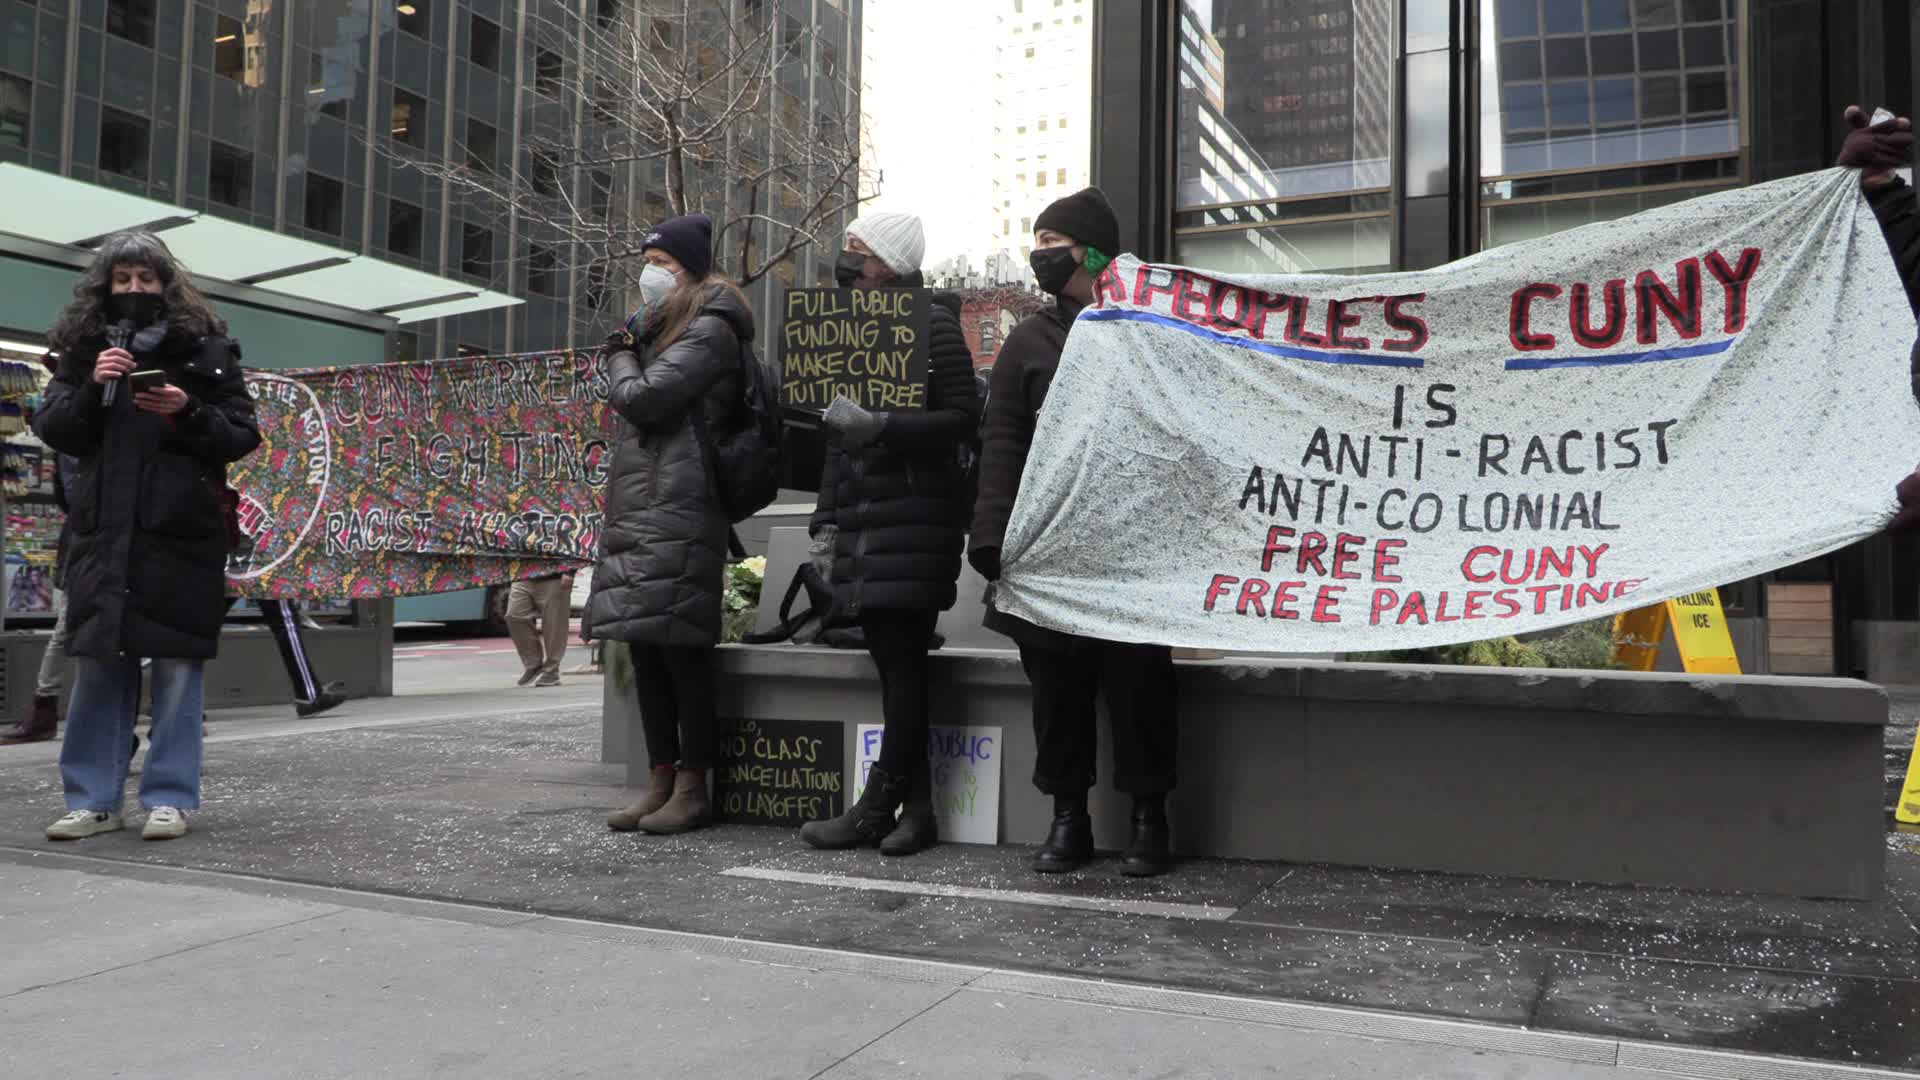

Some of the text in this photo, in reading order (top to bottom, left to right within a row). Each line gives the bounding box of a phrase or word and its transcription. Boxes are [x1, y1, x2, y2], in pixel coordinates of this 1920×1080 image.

[788, 289, 912, 318] FULL PUBLIC
[1092, 258, 1127, 309] A
[1509, 247, 1762, 352] CUNY
[785, 320, 915, 349] FUNDING TO
[334, 350, 610, 426] CUNY WORKERS
[785, 349, 913, 381] MAKE CUNY
[783, 377, 925, 408] TUITION FREE
[1393, 384, 1457, 430] IS
[300, 406, 326, 485] ACTION
[376, 432, 610, 488] FIGHTING
[325, 508, 606, 561] RACIST AUSTERIT
[1261, 525, 1609, 586] FREE CUNY
[1203, 573, 1649, 626] FREE PALESTINE
[1692, 613, 1711, 628] ICE
[754, 736, 822, 762] CLASS
